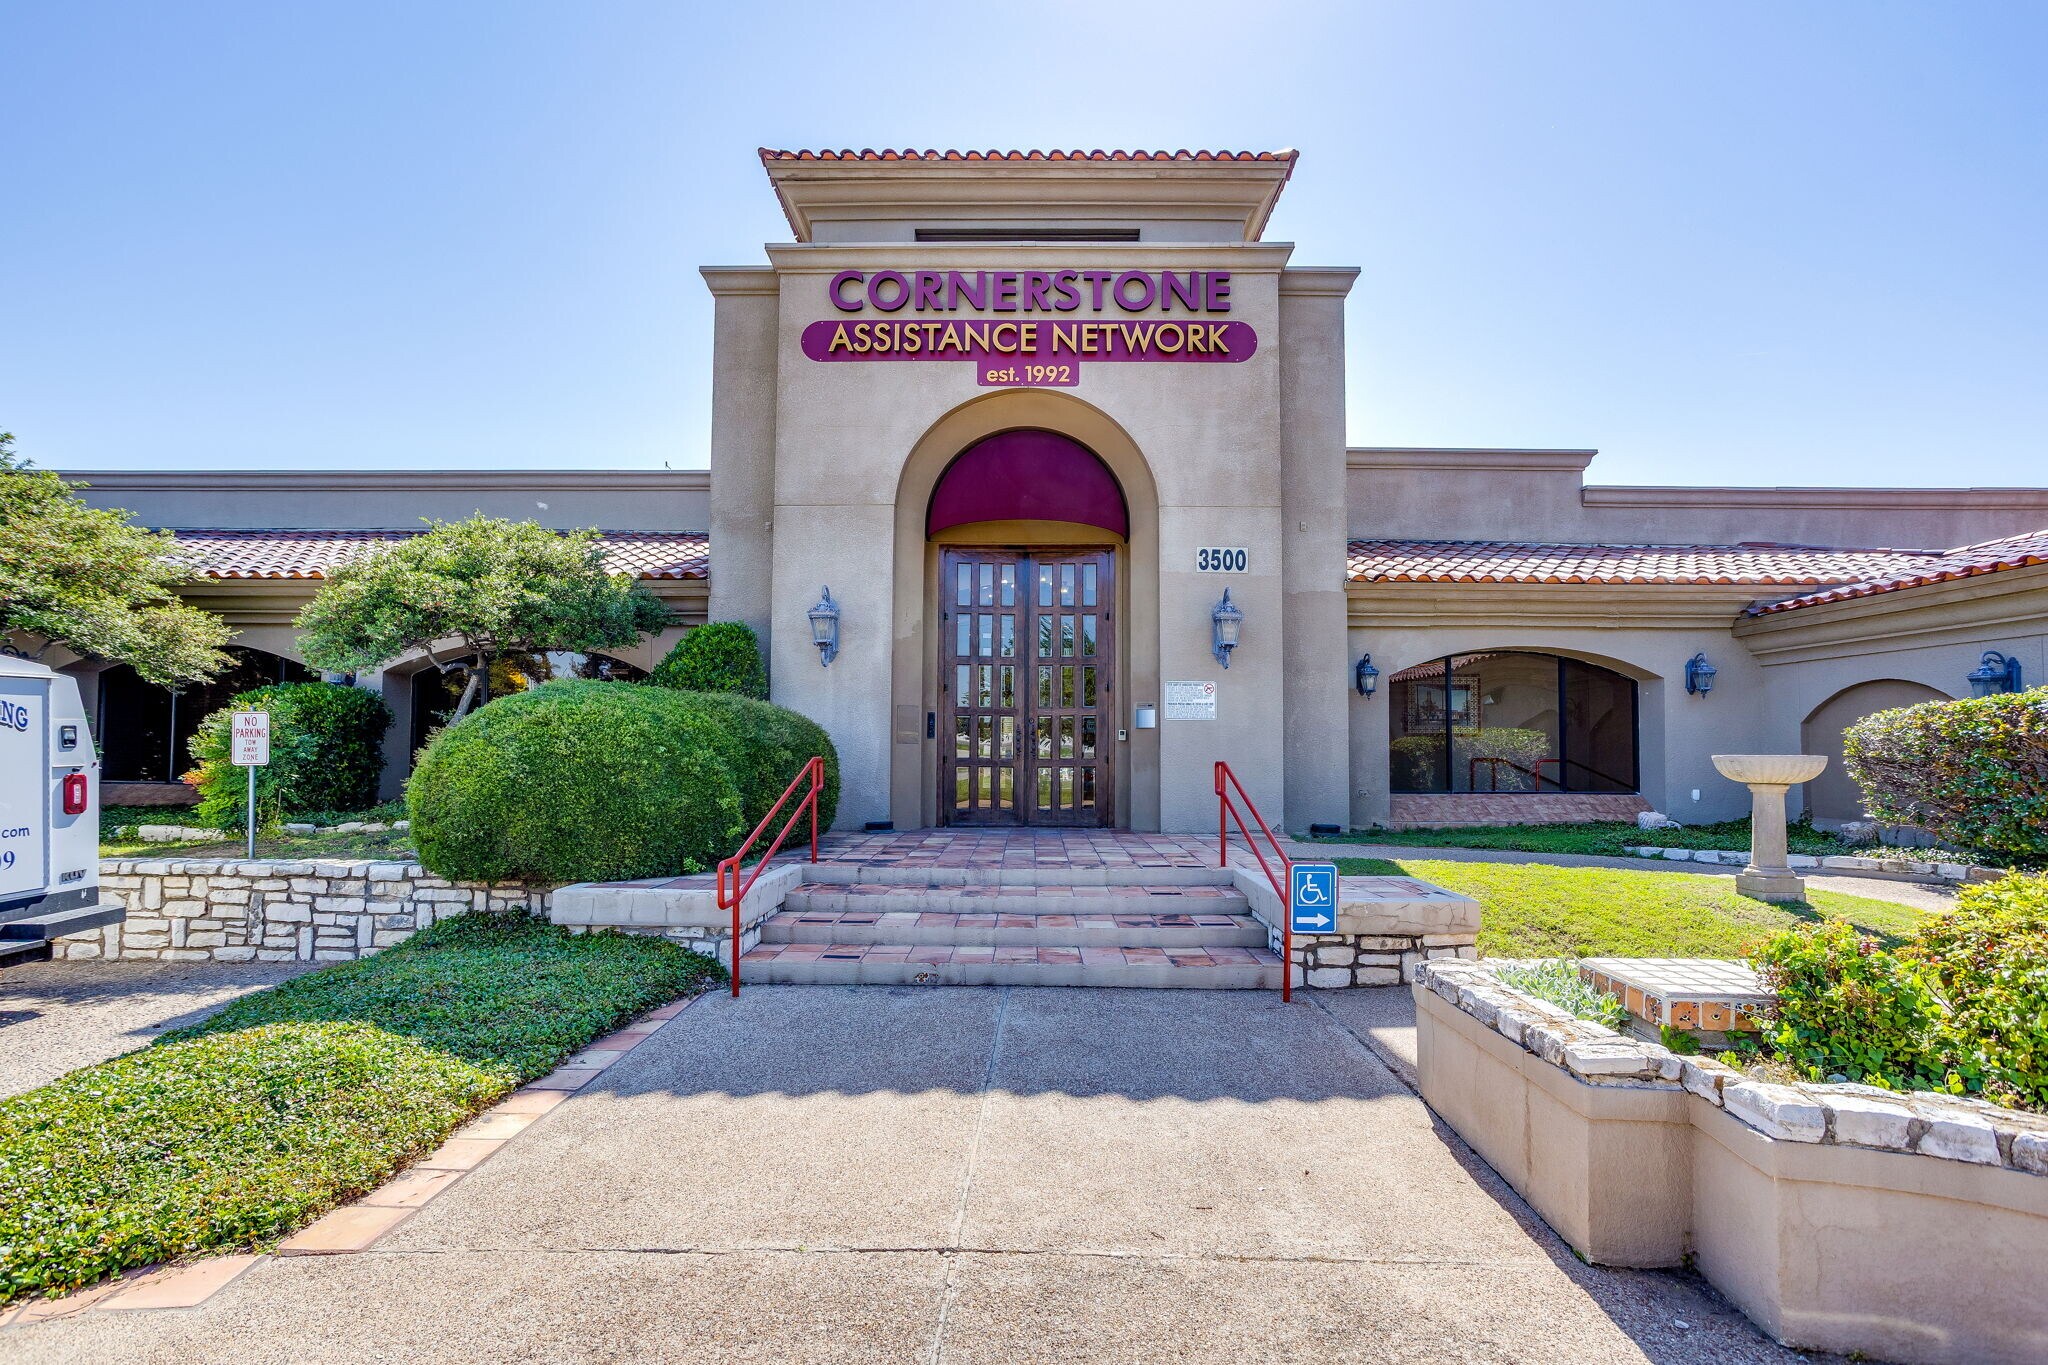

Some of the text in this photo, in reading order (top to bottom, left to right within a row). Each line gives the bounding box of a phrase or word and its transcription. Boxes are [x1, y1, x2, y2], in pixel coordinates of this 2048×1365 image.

[829, 270, 1231, 312] CORNERSTONE
[829, 322, 1230, 354] ASSISTANCE NETWORK
[986, 365, 1071, 382] est. 1992
[1198, 549, 1247, 571] 3500
[0, 700, 29, 729] NG
[244, 717, 258, 727] NO
[235, 728, 266, 738] PARKING
[0, 850, 16, 871] 9
[60, 869, 88, 882] KUV
